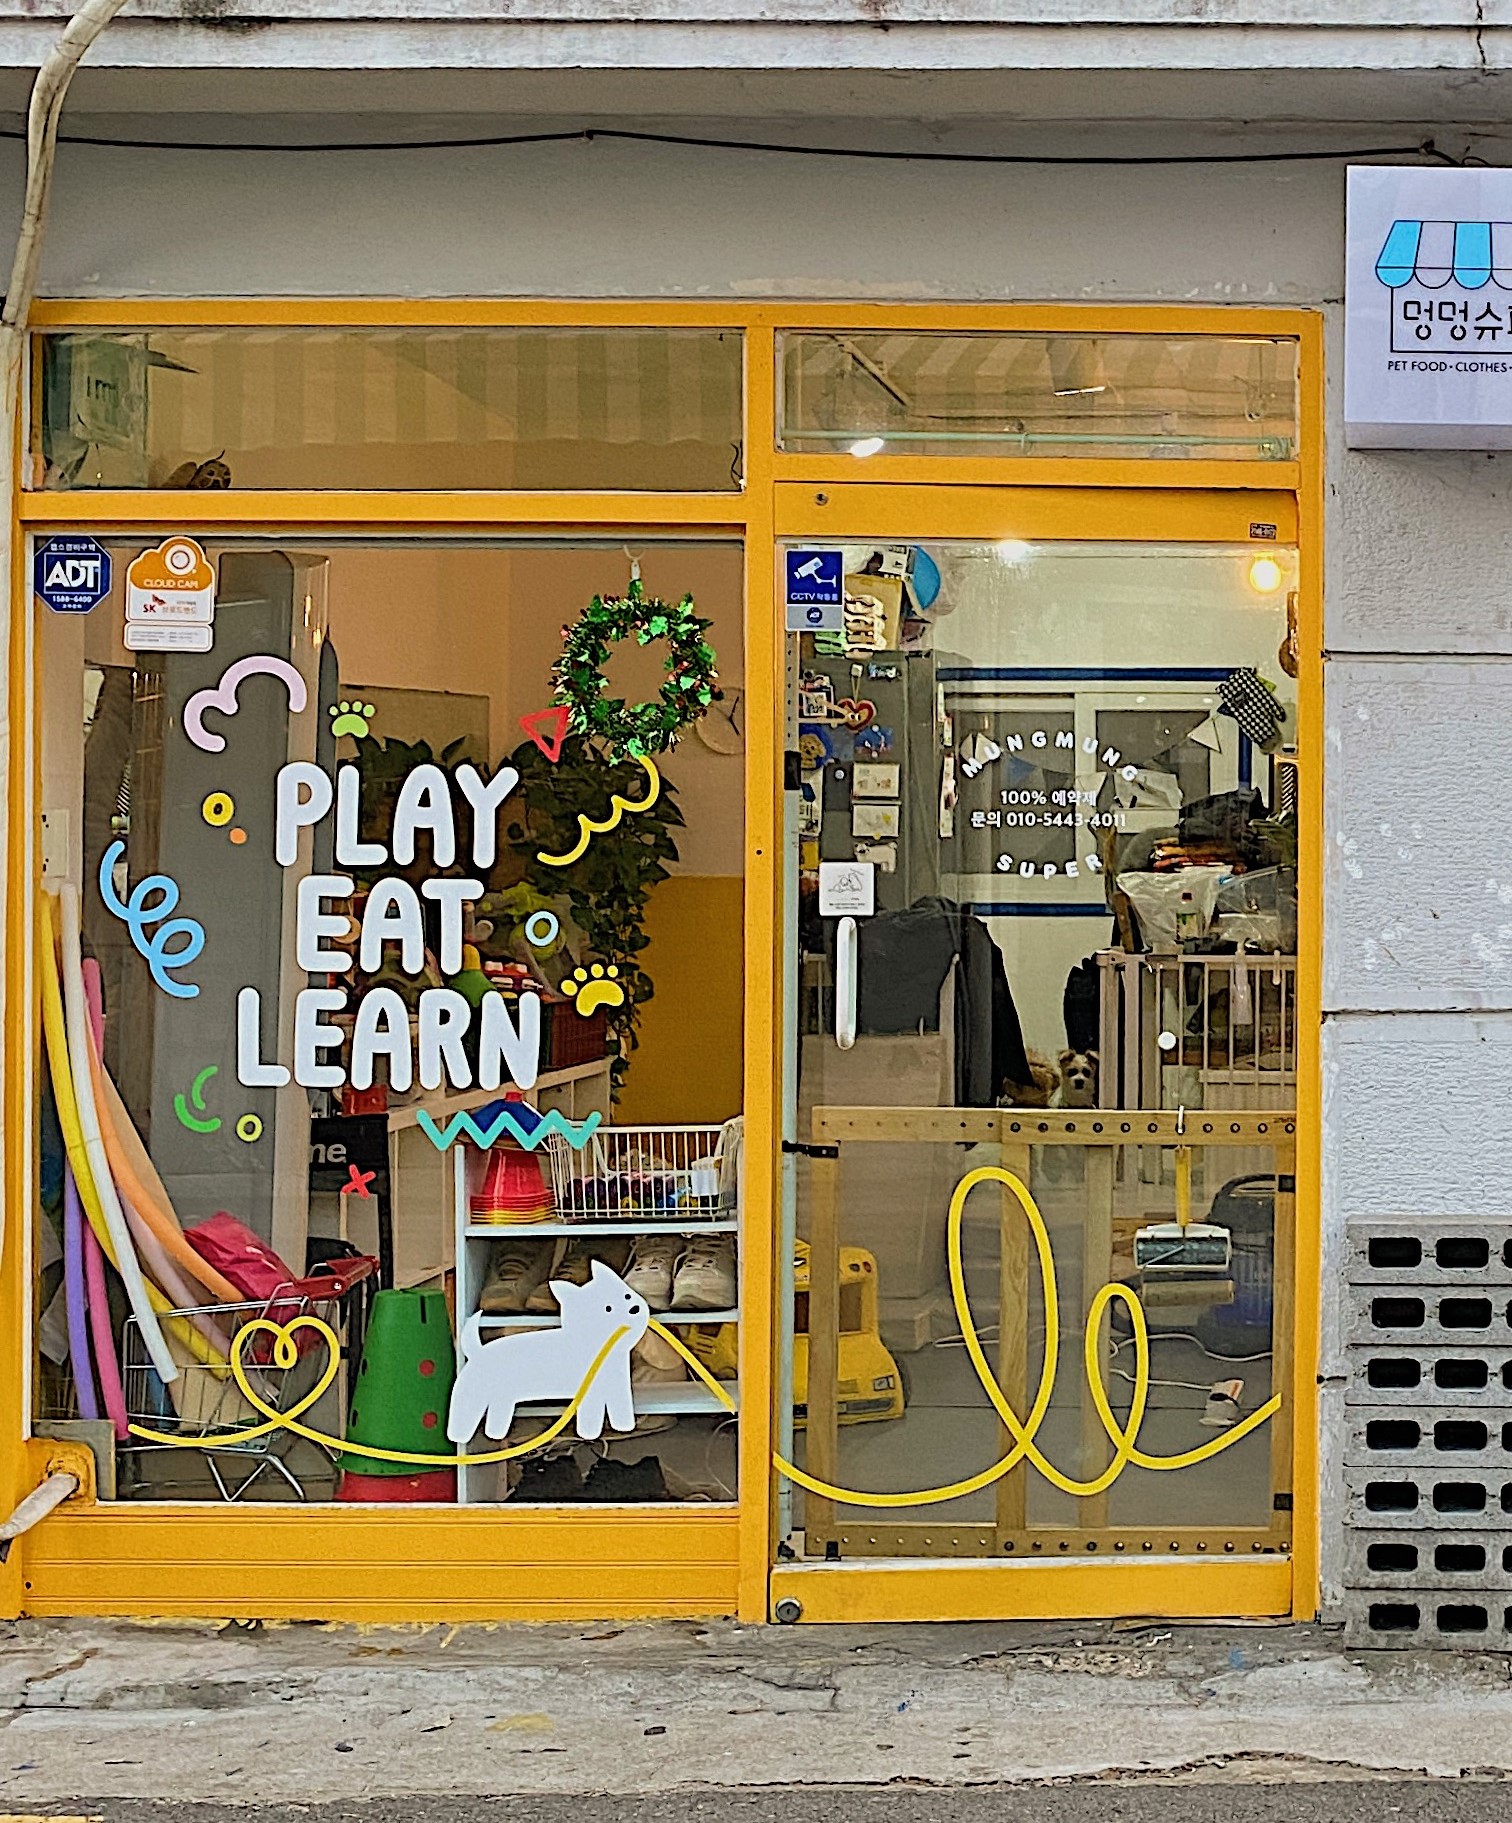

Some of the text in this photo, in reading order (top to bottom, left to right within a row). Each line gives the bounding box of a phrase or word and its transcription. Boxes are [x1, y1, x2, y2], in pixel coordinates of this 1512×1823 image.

[1387, 360, 1408, 371] PET
[1411, 361, 1448, 372] FOOD
[1455, 362, 1508, 373] CLOTHES
[45, 560, 100, 588] ADT
[143, 579, 199, 589] CLOUD CAM
[790, 592, 816, 601] CCTV
[143, 604, 156, 613] SK
[961, 731, 1139, 779] MUNGMUNG
[1001, 790, 1098, 807] 100% 예약제
[275, 762, 519, 869] PLAY
[970, 811, 1127, 828] 문의 010-5443-4011
[996, 854, 1103, 880] SUPER
[298, 874, 485, 976] EAT
[238, 986, 541, 1092] LEARN
